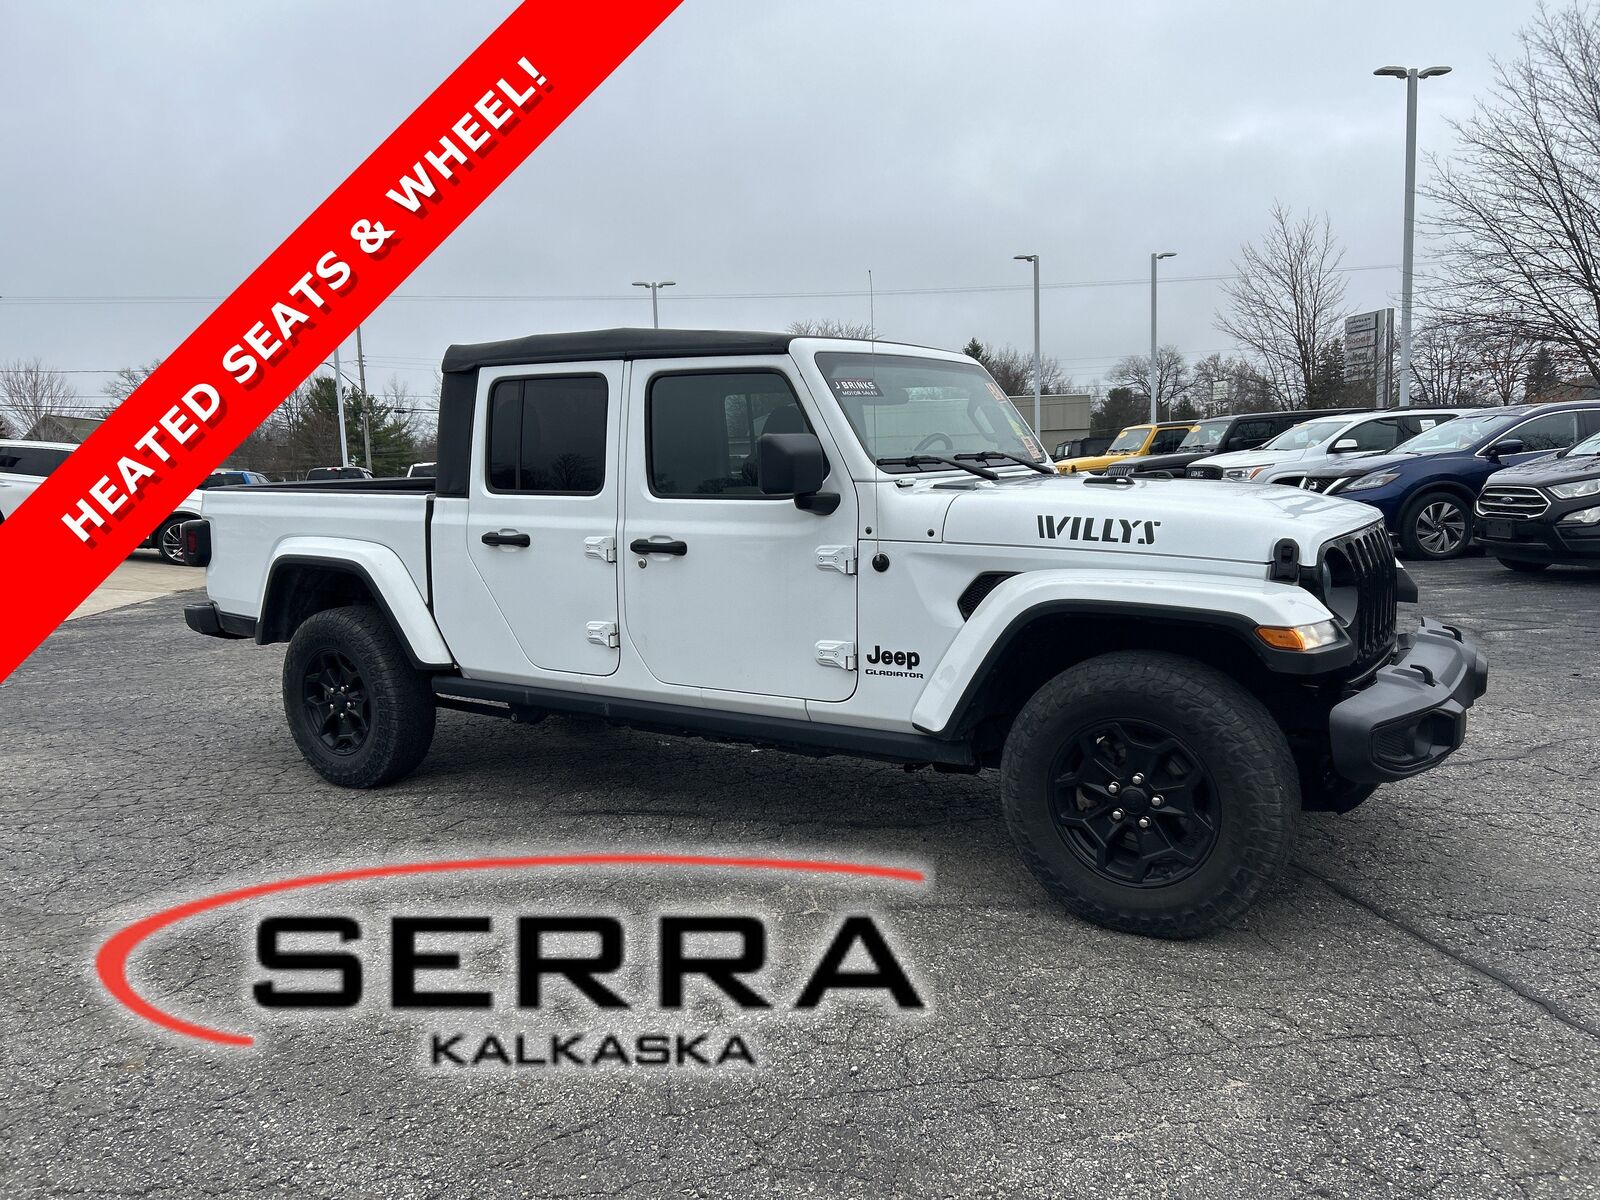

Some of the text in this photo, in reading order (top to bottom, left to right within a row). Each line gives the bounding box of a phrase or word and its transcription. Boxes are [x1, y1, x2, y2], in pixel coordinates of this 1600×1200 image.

[840, 381, 876, 390] BRINKS
[1037, 515, 1161, 545] WILLYS
[866, 645, 920, 670] Jeep
[865, 669, 924, 679] GLADIATOR
